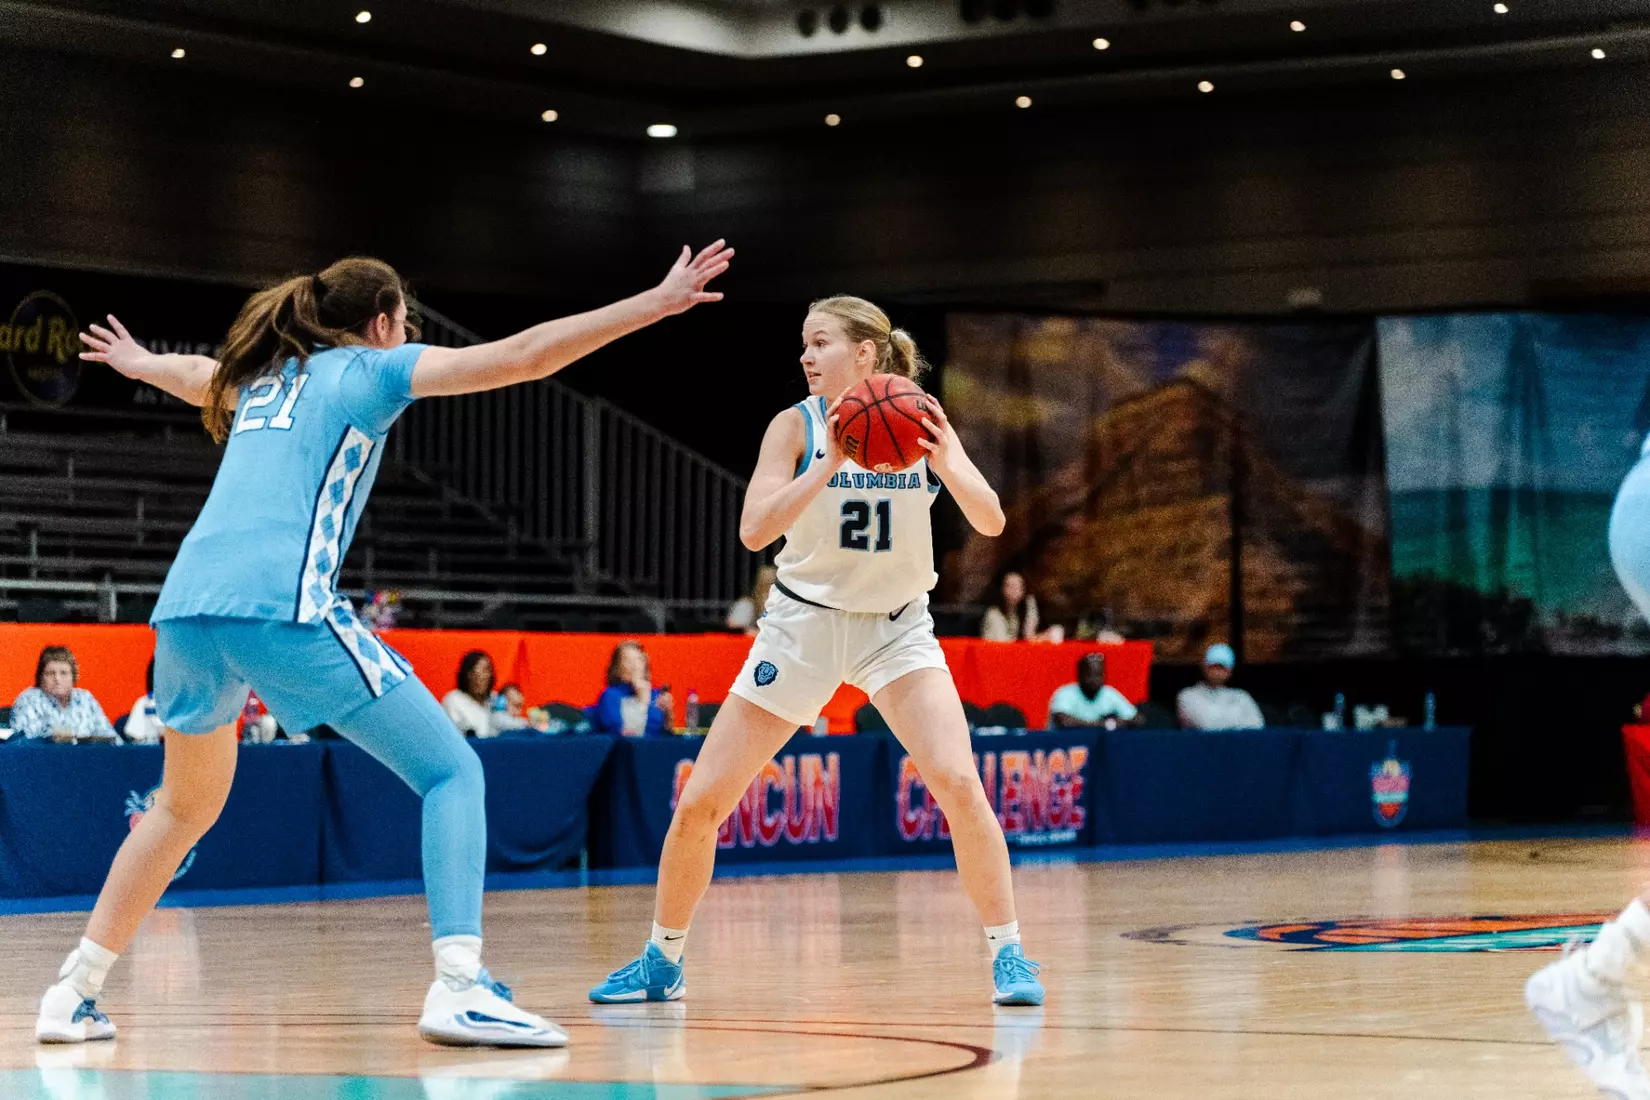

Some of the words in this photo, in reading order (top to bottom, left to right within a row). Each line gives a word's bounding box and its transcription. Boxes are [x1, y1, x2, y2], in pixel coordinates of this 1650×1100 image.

[0, 314, 43, 354] ard
[235, 373, 311, 436] 21
[827, 472, 921, 489] OLUMBIA
[840, 498, 892, 553] 21
[671, 752, 840, 848] NCUN
